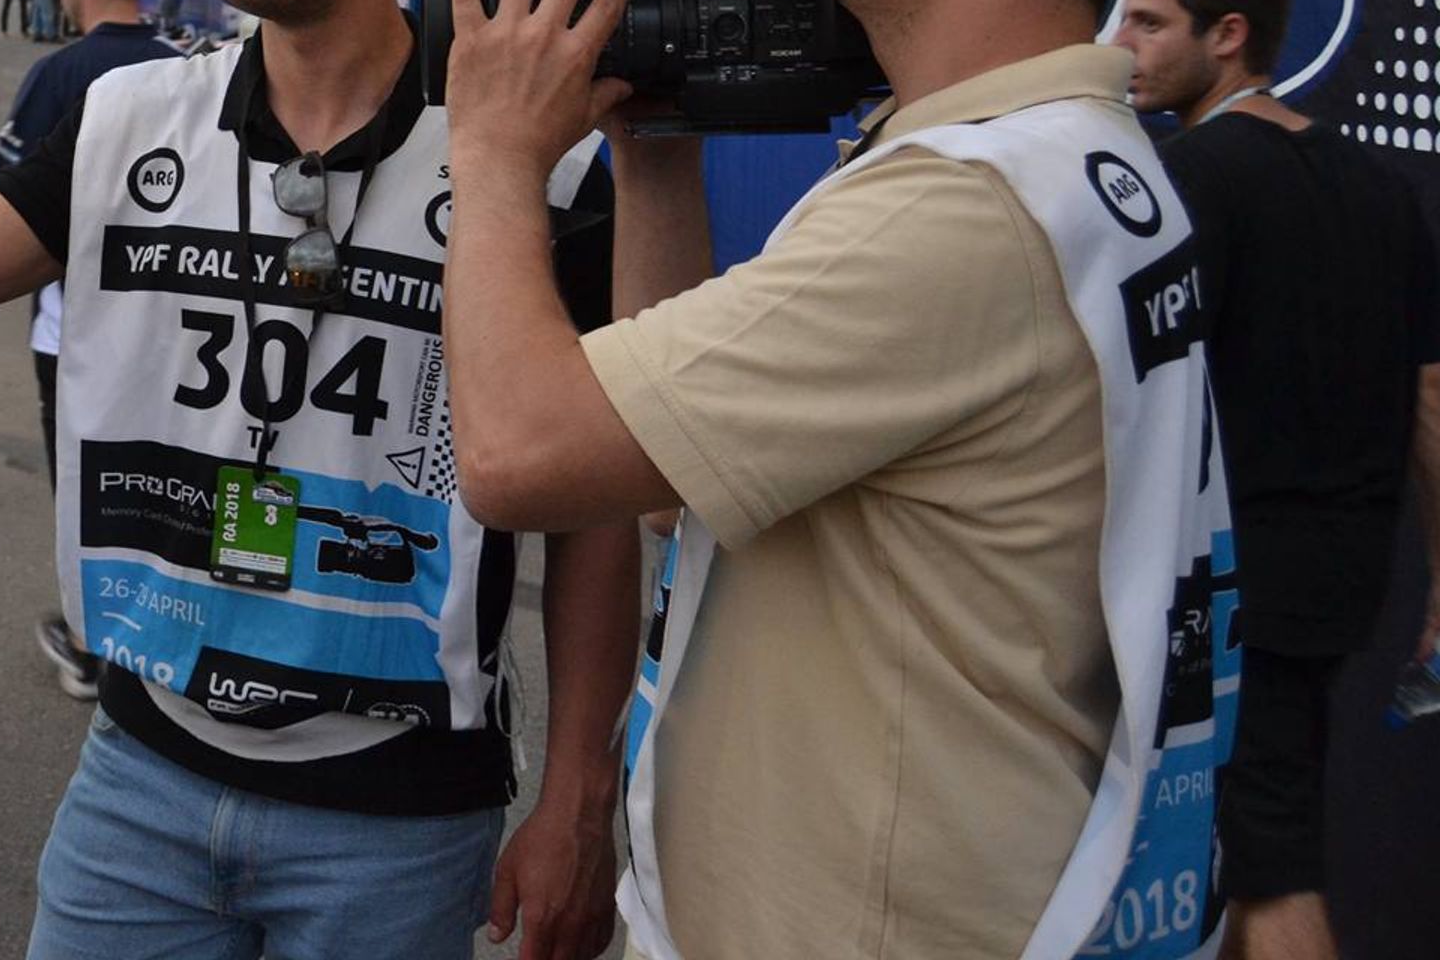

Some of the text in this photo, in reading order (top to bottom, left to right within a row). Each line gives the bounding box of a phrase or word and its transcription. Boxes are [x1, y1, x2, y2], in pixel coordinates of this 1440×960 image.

[142, 170, 174, 186] ARG
[1108, 173, 1140, 205] ARG
[125, 244, 171, 273] YPF
[177, 246, 274, 284] RALY
[173, 309, 389, 436] 304
[100, 472, 217, 511] PROGRA
[224, 482, 240, 519] 2018
[148, 591, 206, 626] APRIL
